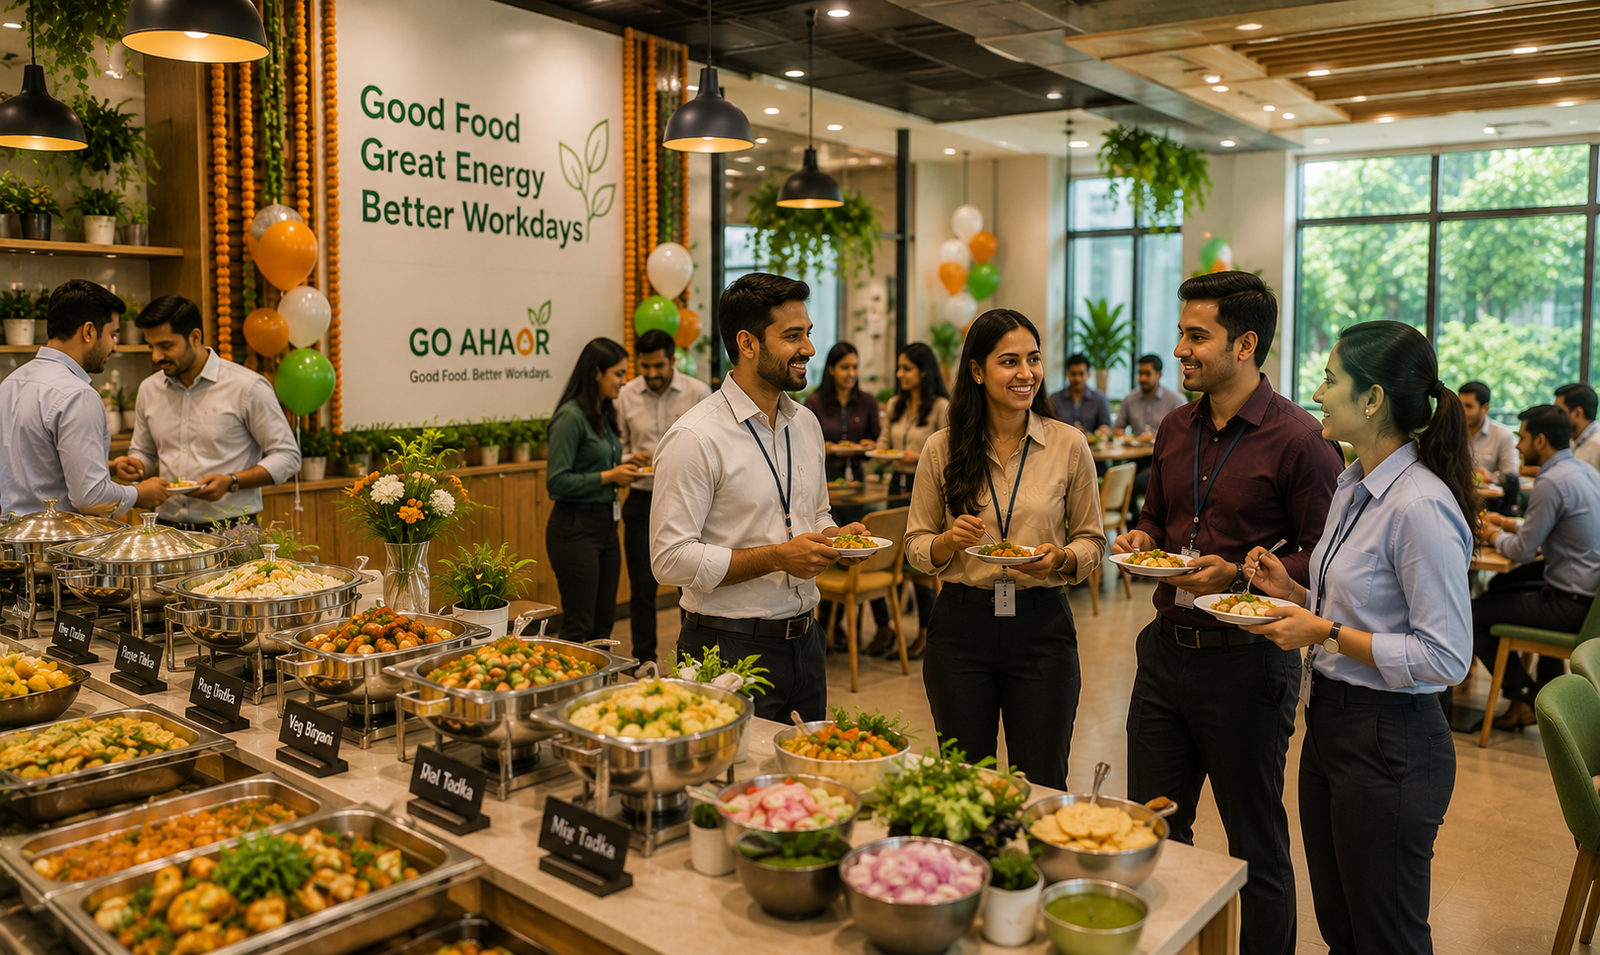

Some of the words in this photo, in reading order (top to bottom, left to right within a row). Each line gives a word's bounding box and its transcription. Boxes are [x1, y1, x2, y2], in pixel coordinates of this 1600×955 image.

[360, 84, 445, 130] Good
[455, 102, 520, 143] Food
[360, 137, 446, 179] Great
[456, 150, 545, 199] Energy
[362, 189, 454, 229] Better
[462, 200, 583, 249] Workdays
[409, 327, 452, 357] GO
[409, 370, 440, 383] Good
[442, 369, 471, 382] Food.
[472, 368, 502, 381] Better
[505, 367, 552, 382] Workdays.
[289, 713, 304, 738] Veg
[304, 721, 335, 746] Biryani
[443, 770, 474, 802] Tadka
[578, 825, 617, 861] Tadka
